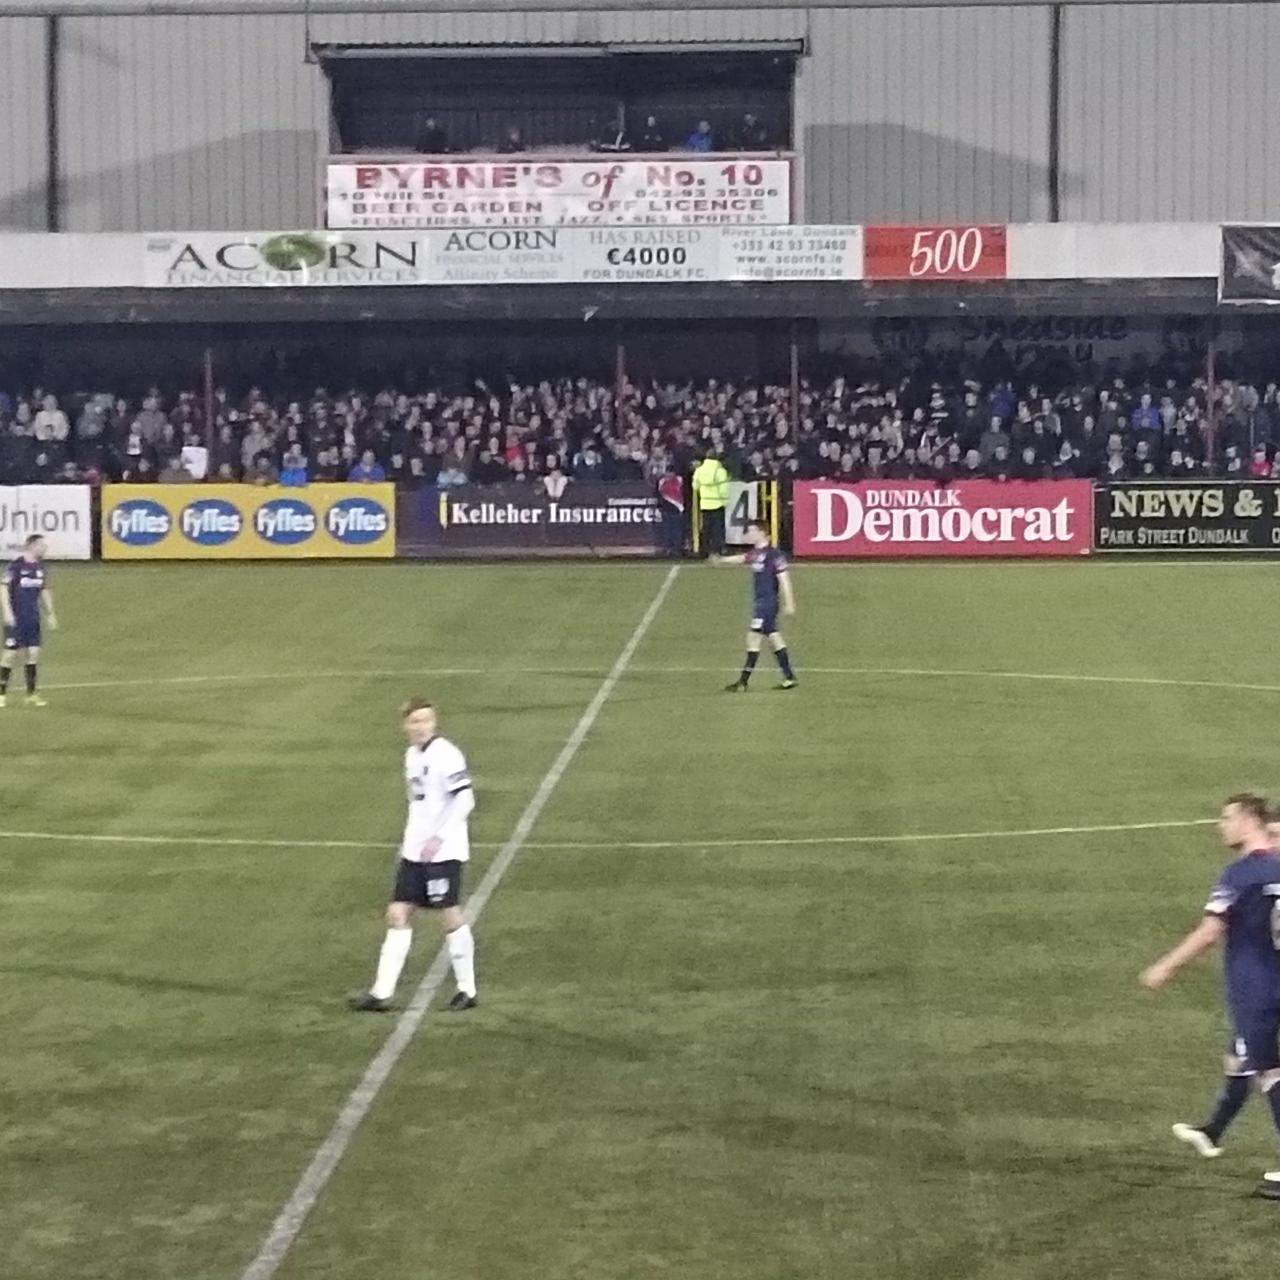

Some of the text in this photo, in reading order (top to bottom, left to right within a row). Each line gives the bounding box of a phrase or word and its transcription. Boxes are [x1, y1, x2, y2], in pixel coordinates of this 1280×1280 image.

[356, 164, 763, 199] BYRNE'S of No. 10
[352, 201, 543, 214] BEER GARDEN
[587, 199, 765, 212] OFF LICENCE
[444, 229, 559, 252] ACORN
[589, 229, 702, 246] HAS RAISED
[171, 234, 418, 273] ACORN
[607, 247, 687, 267] €4000
[909, 227, 983, 277] 500
[583, 269, 612, 281] FOR
[616, 269, 682, 281] DUNDALK
[865, 489, 962, 507] DUNDALK
[1110, 488, 1225, 518] NEWS
[1233, 488, 1263, 518] &
[451, 501, 662, 524] Kelleher Insurances
[730, 488, 766, 536] 4
[810, 488, 1075, 542] Democrat
[1100, 526, 1249, 544] PARK STREET DUNDALK
